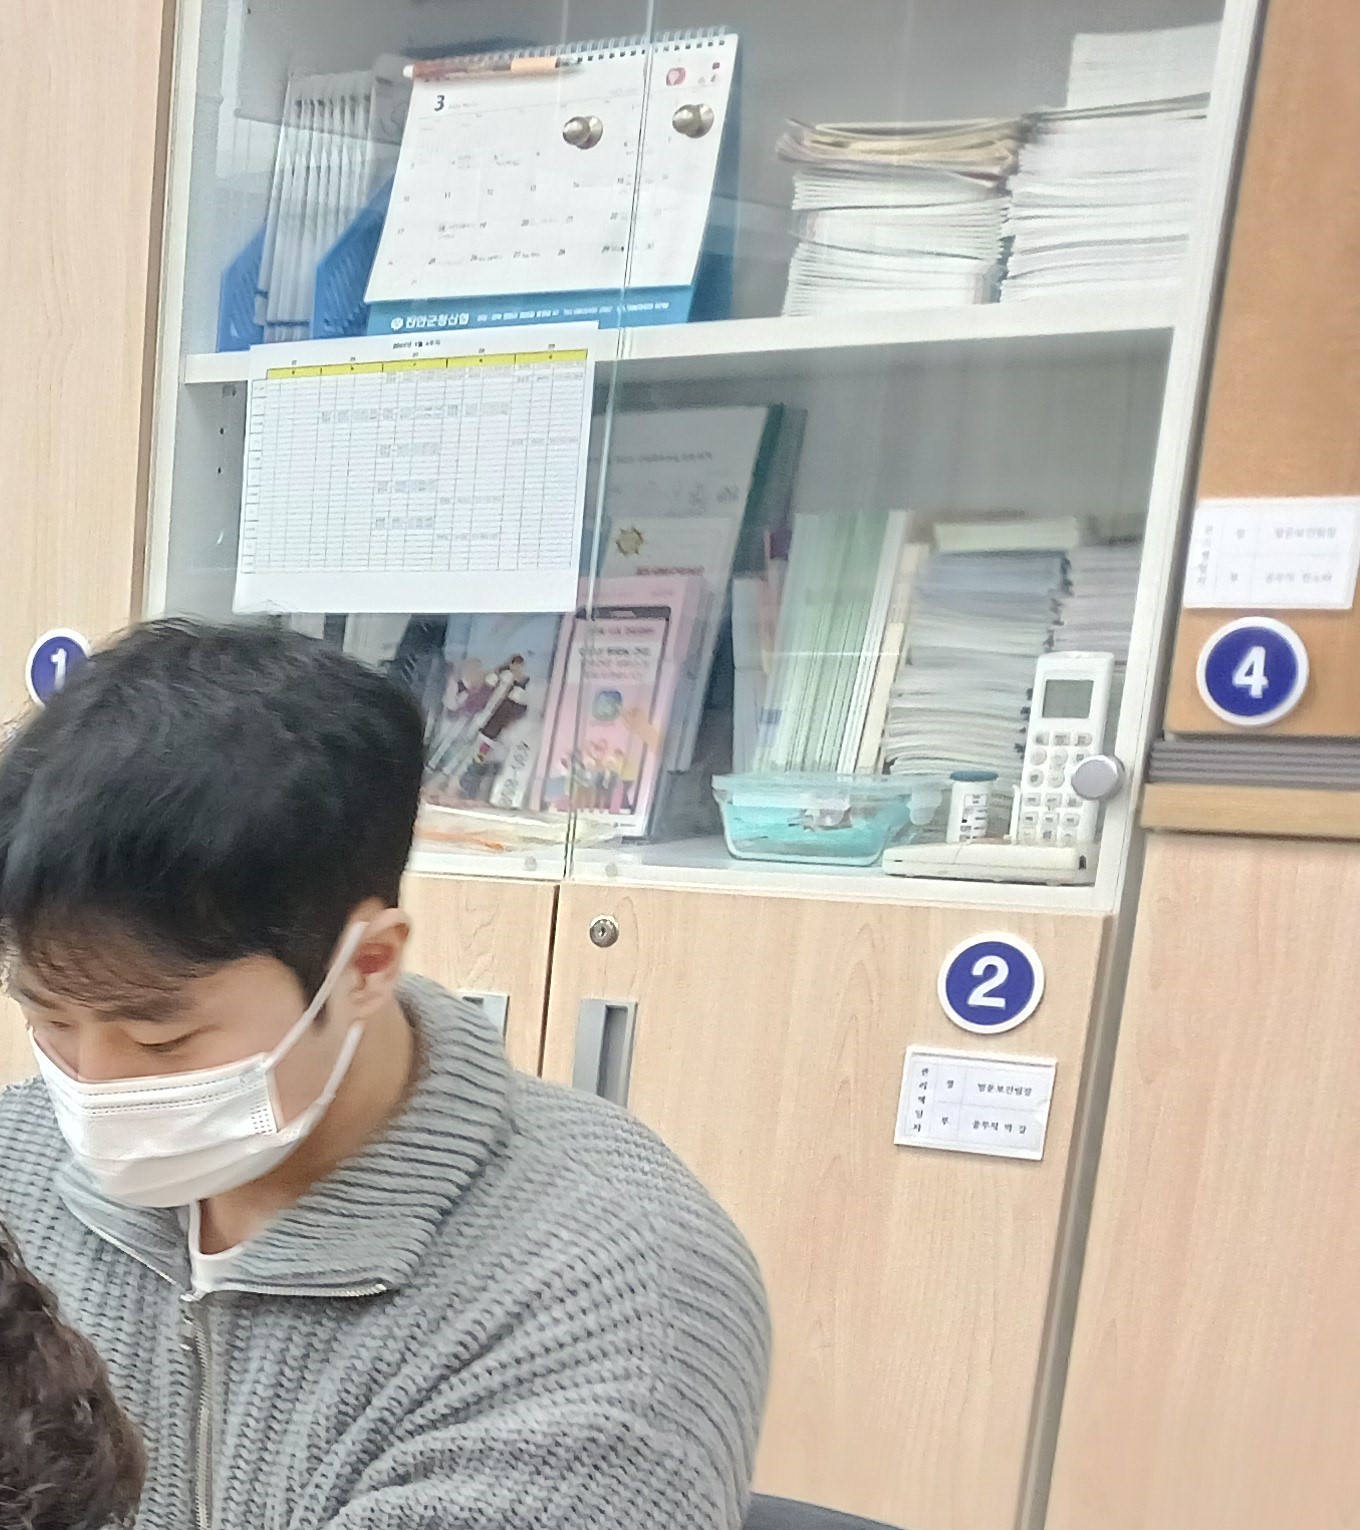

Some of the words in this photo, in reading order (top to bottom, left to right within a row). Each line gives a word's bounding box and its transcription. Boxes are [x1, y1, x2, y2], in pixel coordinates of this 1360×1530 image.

[433, 94, 445, 111] 3
[50, 648, 68, 693] 1
[1232, 645, 1270, 699] 4
[967, 955, 1009, 1010] 2
